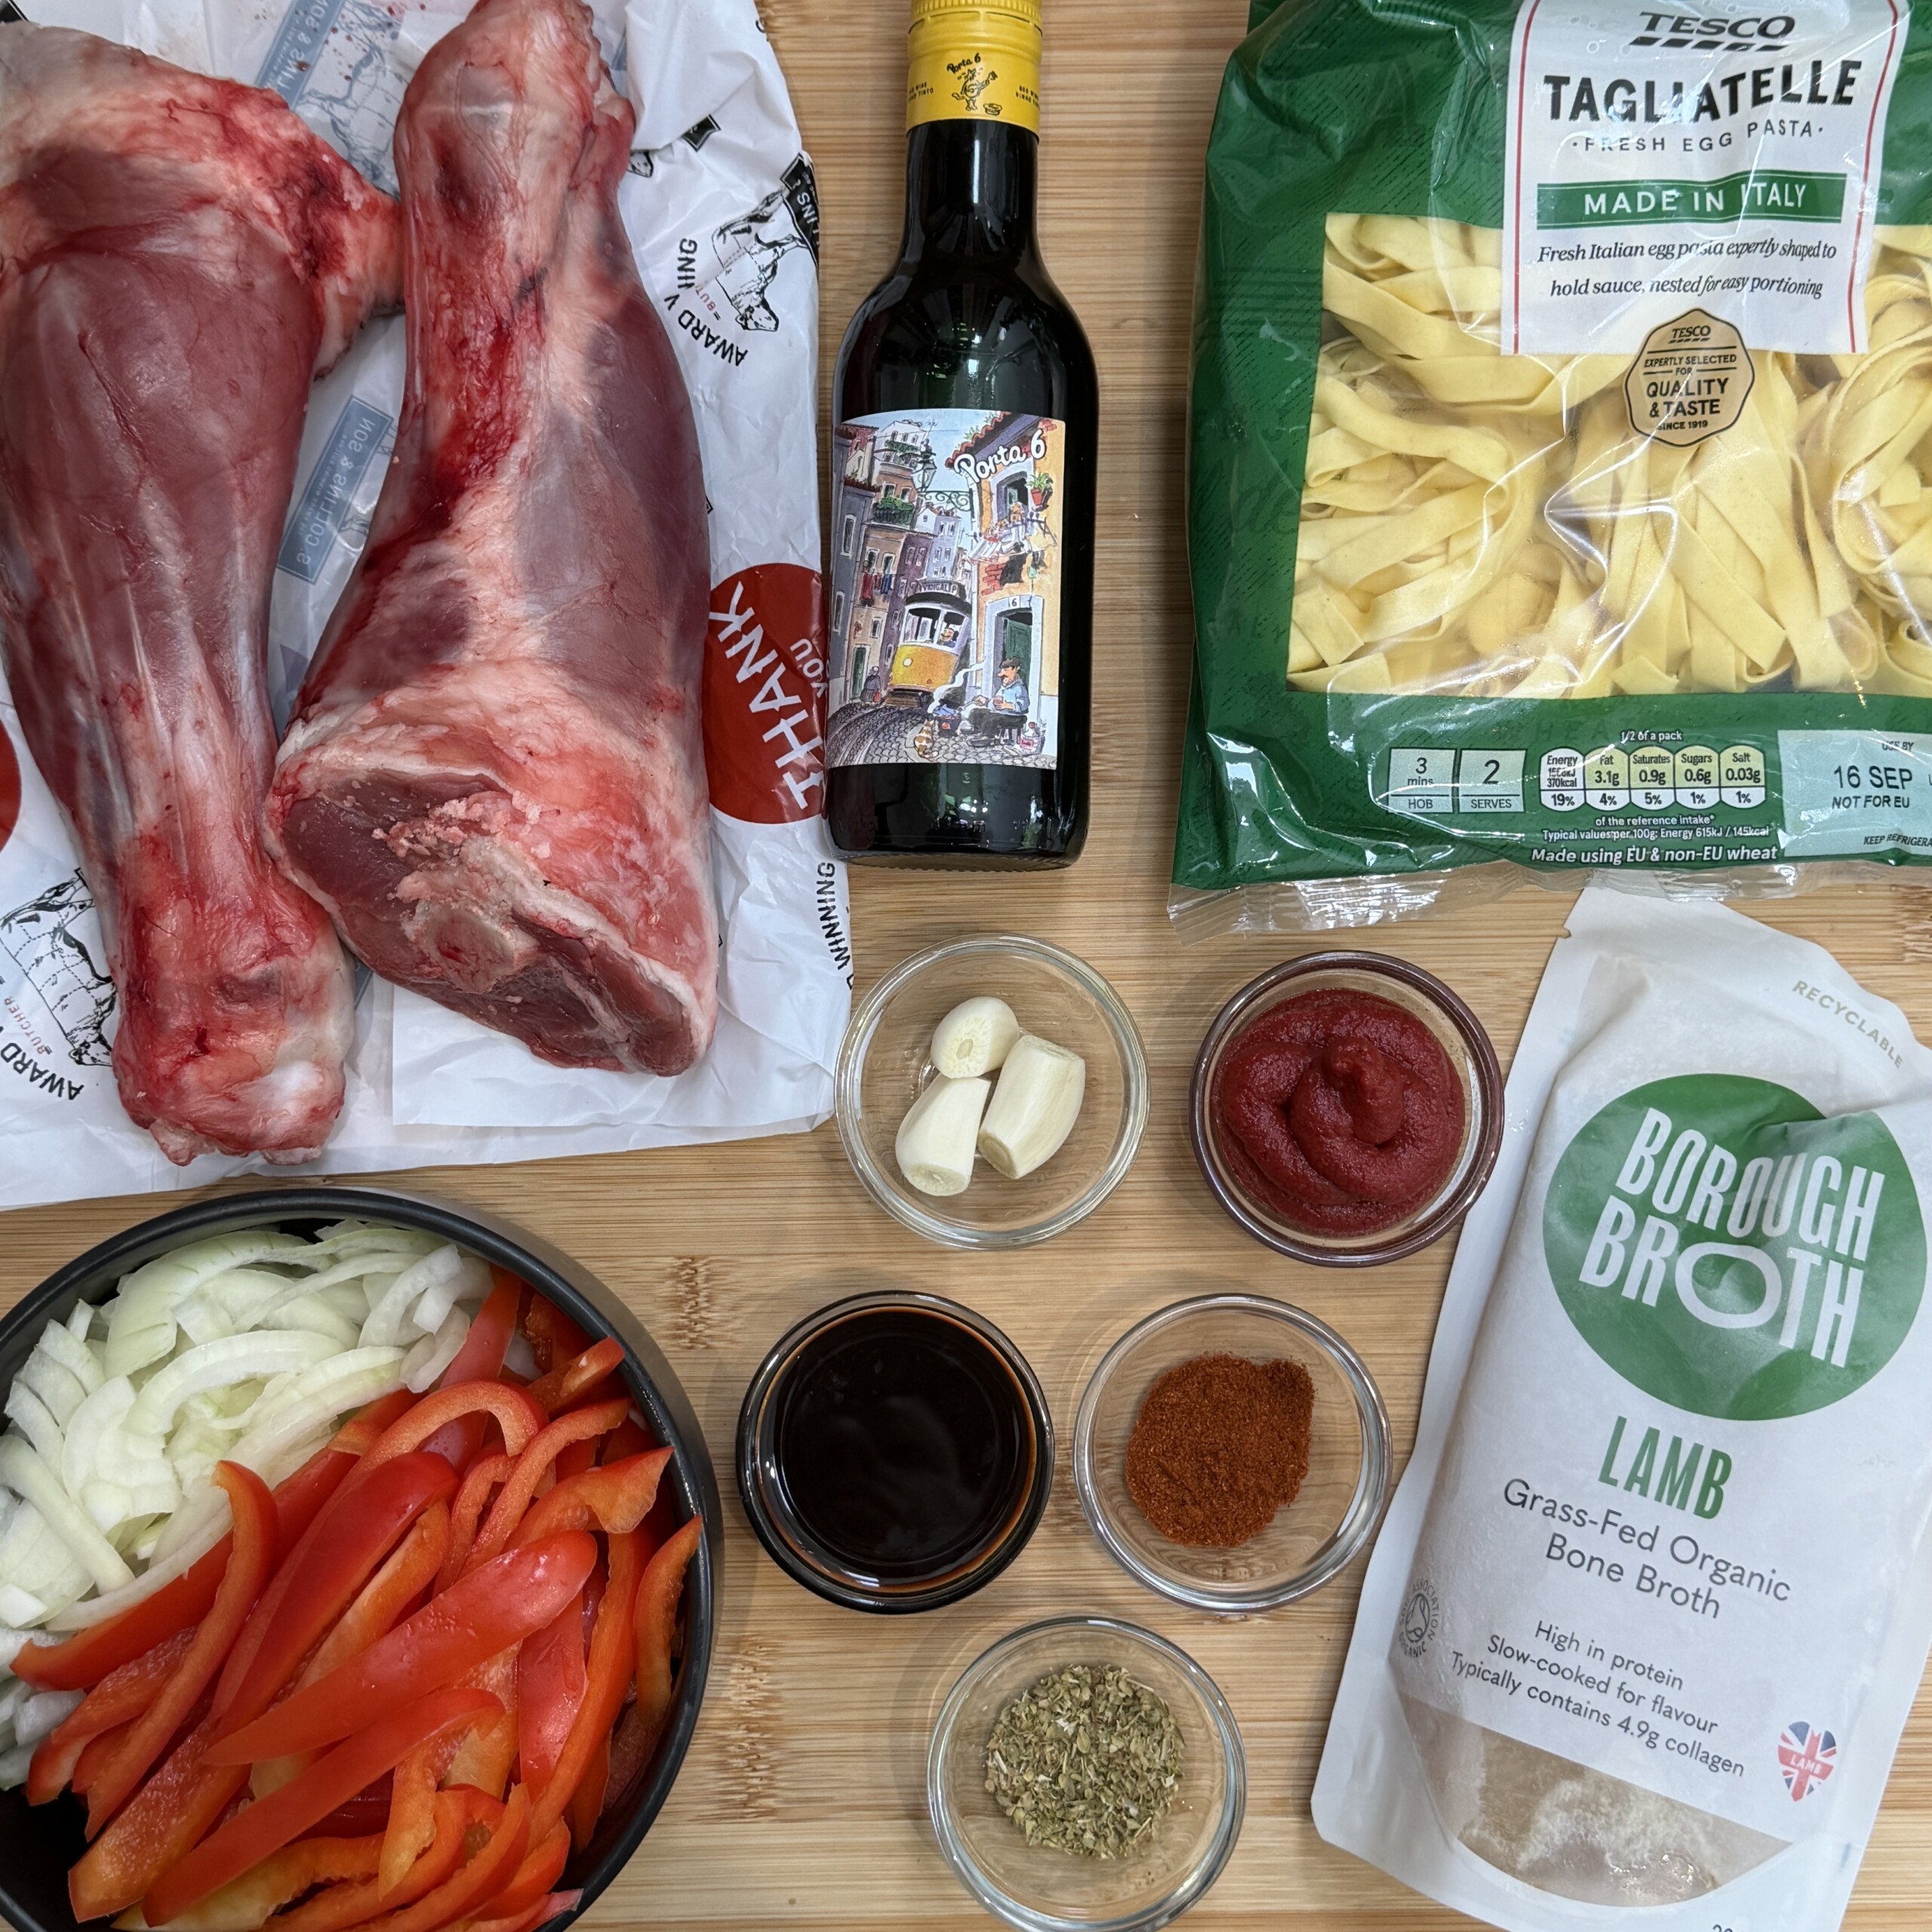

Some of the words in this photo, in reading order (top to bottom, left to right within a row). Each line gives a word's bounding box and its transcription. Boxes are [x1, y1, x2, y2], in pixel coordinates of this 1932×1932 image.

[1638, 11, 1795, 39] TESCO
[946, 58, 973, 74] Porta
[974, 52, 981, 63] 6
[1543, 60, 1862, 123] TAGLIATELLE
[1584, 136, 1666, 152] FRESH
[1683, 131, 1734, 152] EGG
[1747, 119, 1814, 140] PASTA
[1584, 190, 1677, 216] MADE
[1694, 189, 1724, 212] IN
[1740, 183, 1807, 208] ITALY
[1538, 245, 1586, 263] Fresh
[1589, 242, 1644, 260] Italian
[1647, 245, 1675, 260] egg
[1677, 242, 1724, 259] pasta
[1726, 238, 1780, 257] expertly
[1780, 240, 1822, 262] shaped
[1823, 242, 1836, 259] to
[1550, 279, 1589, 297] hold
[1592, 278, 1647, 295] sauce,
[1649, 276, 1700, 293] nested
[1699, 275, 1722, 297] for
[1721, 275, 1749, 293] easy
[1749, 275, 1823, 299] portioning
[678, 309, 749, 367] AWARD
[1672, 325, 1712, 338] TESCO
[1644, 355, 1684, 368] EXPERTLY
[1684, 353, 1737, 366] SELECTED
[1675, 367, 1692, 376] FOR
[1646, 377, 1729, 398] QUALITY
[1649, 401, 1660, 417] &
[1663, 398, 1721, 417] TASTE
[1657, 420, 1685, 431] SINCE
[1687, 420, 1708, 429] 1919
[953, 450, 1026, 483] Porta
[1030, 428, 1047, 457] 6
[1011, 598, 1017, 607] 6
[709, 580, 824, 810] THANK
[1638, 731, 1649, 741] of
[1658, 731, 1682, 743] pack
[1902, 742, 1915, 752] BY
[1415, 757, 1427, 774] 3
[1546, 755, 1578, 767] Energy
[1599, 755, 1614, 765] Fat
[1632, 754, 1671, 764] Saturates
[1681, 754, 1712, 765] Sugars
[1732, 752, 1751, 763] Salt
[1407, 776, 1434, 786] mins
[1483, 759, 1500, 786] 2
[1595, 770, 1620, 786] 3.1g
[1639, 769, 1666, 786] 0.9g
[1684, 768, 1712, 785] 0.6g
[1725, 768, 1761, 783] 0.03g
[1834, 765, 1861, 789] 16
[1869, 765, 1913, 790] SEP
[1546, 777, 1577, 788] 370kcal
[1408, 798, 1433, 810] HOB
[1471, 798, 1512, 809] SERVES
[1551, 793, 1575, 807] 19%
[1599, 792, 1617, 807] 4%
[1644, 792, 1663, 805] 5%
[1690, 792, 1706, 804] 1%
[1736, 791, 1752, 804] 1%
[1832, 796, 1862, 809] NOT
[1863, 795, 1892, 808] FOR
[1894, 796, 1910, 808] EU
[1595, 816, 1607, 826] of
[1607, 816, 1625, 826] the
[1626, 815, 1677, 826] reference
[1543, 829, 1577, 841] Typical
[1633, 829, 1658, 840] 100g:
[1660, 828, 1694, 840] Energy
[1696, 827, 1723, 838] 615kJ
[1863, 835, 1885, 845] KEEP
[1531, 848, 1577, 863] Made
[1580, 848, 1622, 865] using
[1626, 848, 1646, 863] EU
[1650, 848, 1660, 862] &
[1664, 846, 1723, 862] non-EU
[1727, 845, 1778, 860] wheat
[816, 862, 851, 971] WINNING
[4, 995, 46, 1055] BUTCHER
[1792, 980, 1903, 1069] RECYCLABLE
[1, 1042, 85, 1100] AWARD
[1615, 1107, 1885, 1262] BOROUGH
[1579, 1195, 1864, 1368] BROTH
[1598, 1415, 1733, 1520] LAMB
[1503, 1478, 1660, 1553] Grass-Fed
[1669, 1534, 1792, 1601] Organic
[1545, 1532, 1625, 1583] Bone
[1635, 1563, 1721, 1619] Broth
[1535, 1620, 1580, 1656] High
[1587, 1639, 1606, 1660] in
[1611, 1654, 1684, 1691] protein
[1487, 1633, 1611, 1695] Slow-cooked
[1616, 1681, 1646, 1707] for
[1651, 1695, 1719, 1735] flavour
[1451, 1651, 1523, 1696] Typically
[1527, 1683, 1611, 1727] contains
[1617, 1714, 1660, 1750] 4.9g
[1665, 1736, 1746, 1777] collagen
[1789, 1754, 1822, 1774] LAMB
